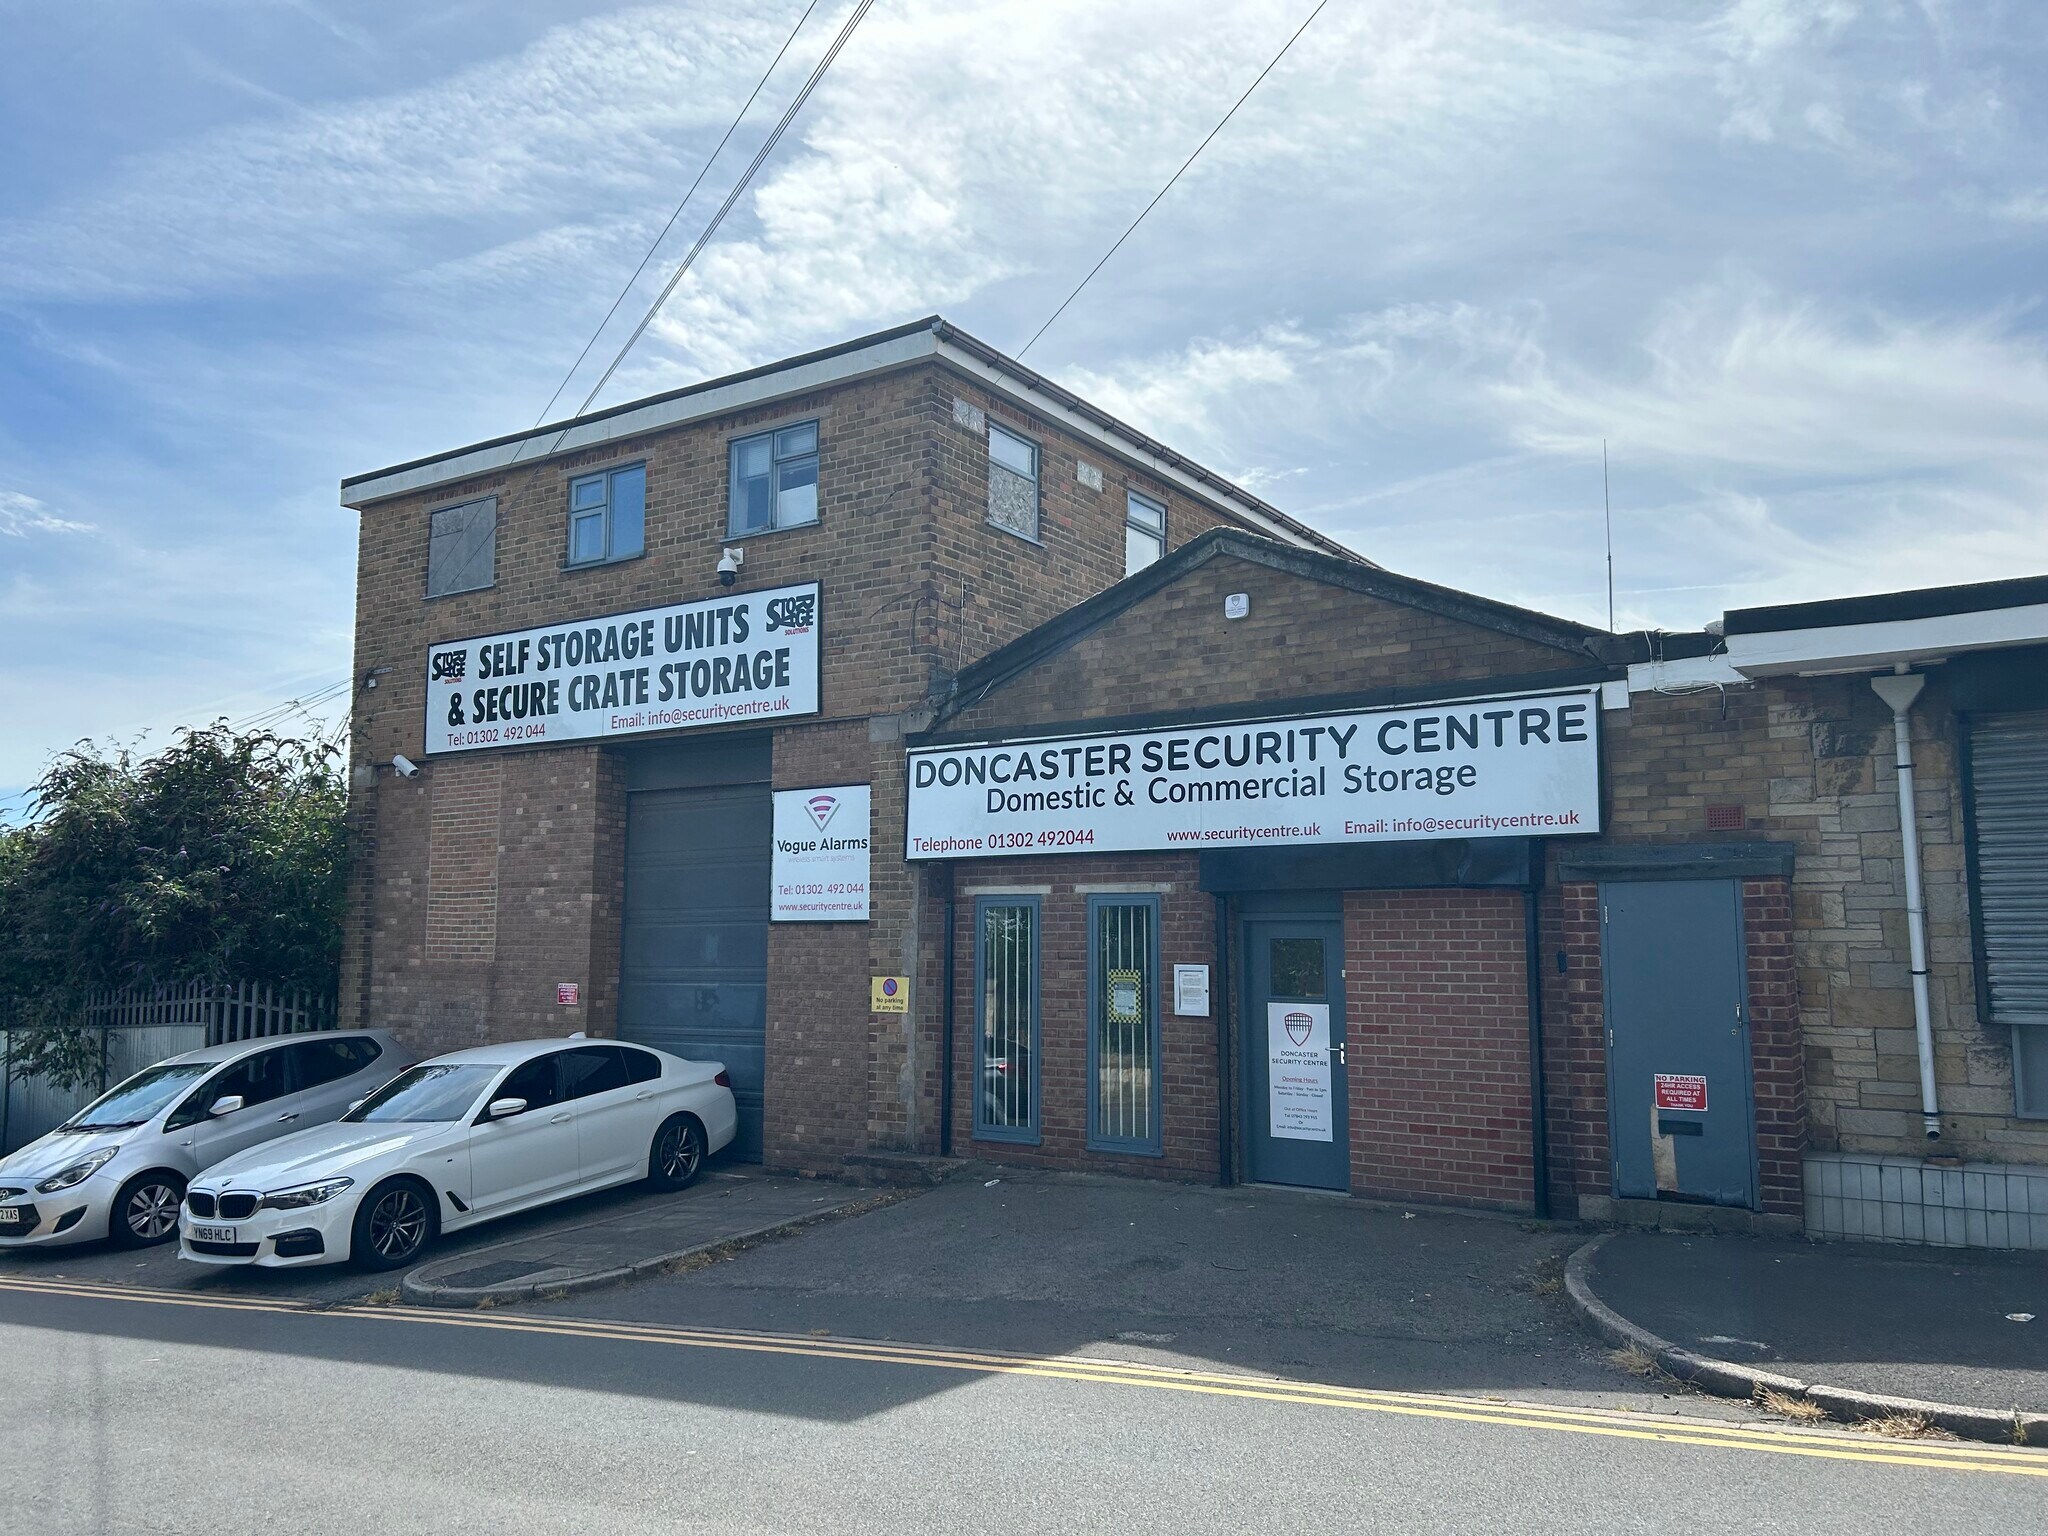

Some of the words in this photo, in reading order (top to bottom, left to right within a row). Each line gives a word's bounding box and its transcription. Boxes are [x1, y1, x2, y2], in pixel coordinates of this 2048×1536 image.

[766, 593, 815, 633] STORAGE
[785, 627, 809, 636] SOLUTIONS
[479, 638, 530, 680] SELF
[537, 619, 655, 671] STORAGE
[664, 603, 750, 653] UNITS
[447, 692, 466, 727] &
[472, 679, 560, 725] SECURE
[568, 666, 649, 713] CRATE
[658, 647, 790, 702] STORAGE
[611, 712, 645, 730] Email:
[648, 695, 790, 726] info@securitycentre.uk
[447, 733, 465, 747] Tel:
[466, 728, 499, 745] 01302
[503, 725, 523, 741] 492
[525, 723, 546, 738] 044
[915, 743, 1131, 789] DONCASTER
[1141, 723, 1358, 773] SECURITY
[1377, 703, 1588, 756] CENTRE
[986, 781, 1106, 813] Domestic
[1114, 778, 1135, 807] &
[1148, 765, 1326, 804] Commercial
[1343, 763, 1477, 796] Storage
[1344, 818, 1389, 835] Email:
[1392, 809, 1580, 832] info@securitycentre.uk
[1167, 822, 1321, 841] www.securitycentre.uk
[777, 839, 817, 855] Vogue
[820, 837, 868, 851] Alarms
[913, 836, 983, 854] Telephone
[987, 831, 1034, 850] 01302
[1037, 828, 1095, 846] 492044
[778, 885, 794, 895] Tel:
[795, 884, 823, 895] 01302
[827, 883, 845, 894] 492
[846, 883, 865, 894] 044
[778, 901, 863, 912] www.securitycentre.uk
[884, 997, 904, 1005] parking
[1280, 1050, 1318, 1058] DONCASTER
[1302, 1059, 1328, 1067] CENTRE
[1282, 1075, 1302, 1083] Opening
[1669, 1075, 1705, 1083] PARKING
[5, 1209, 18, 1220] XAS
[193, 1226, 213, 1240] YN69
[214, 1228, 231, 1241] HLC
